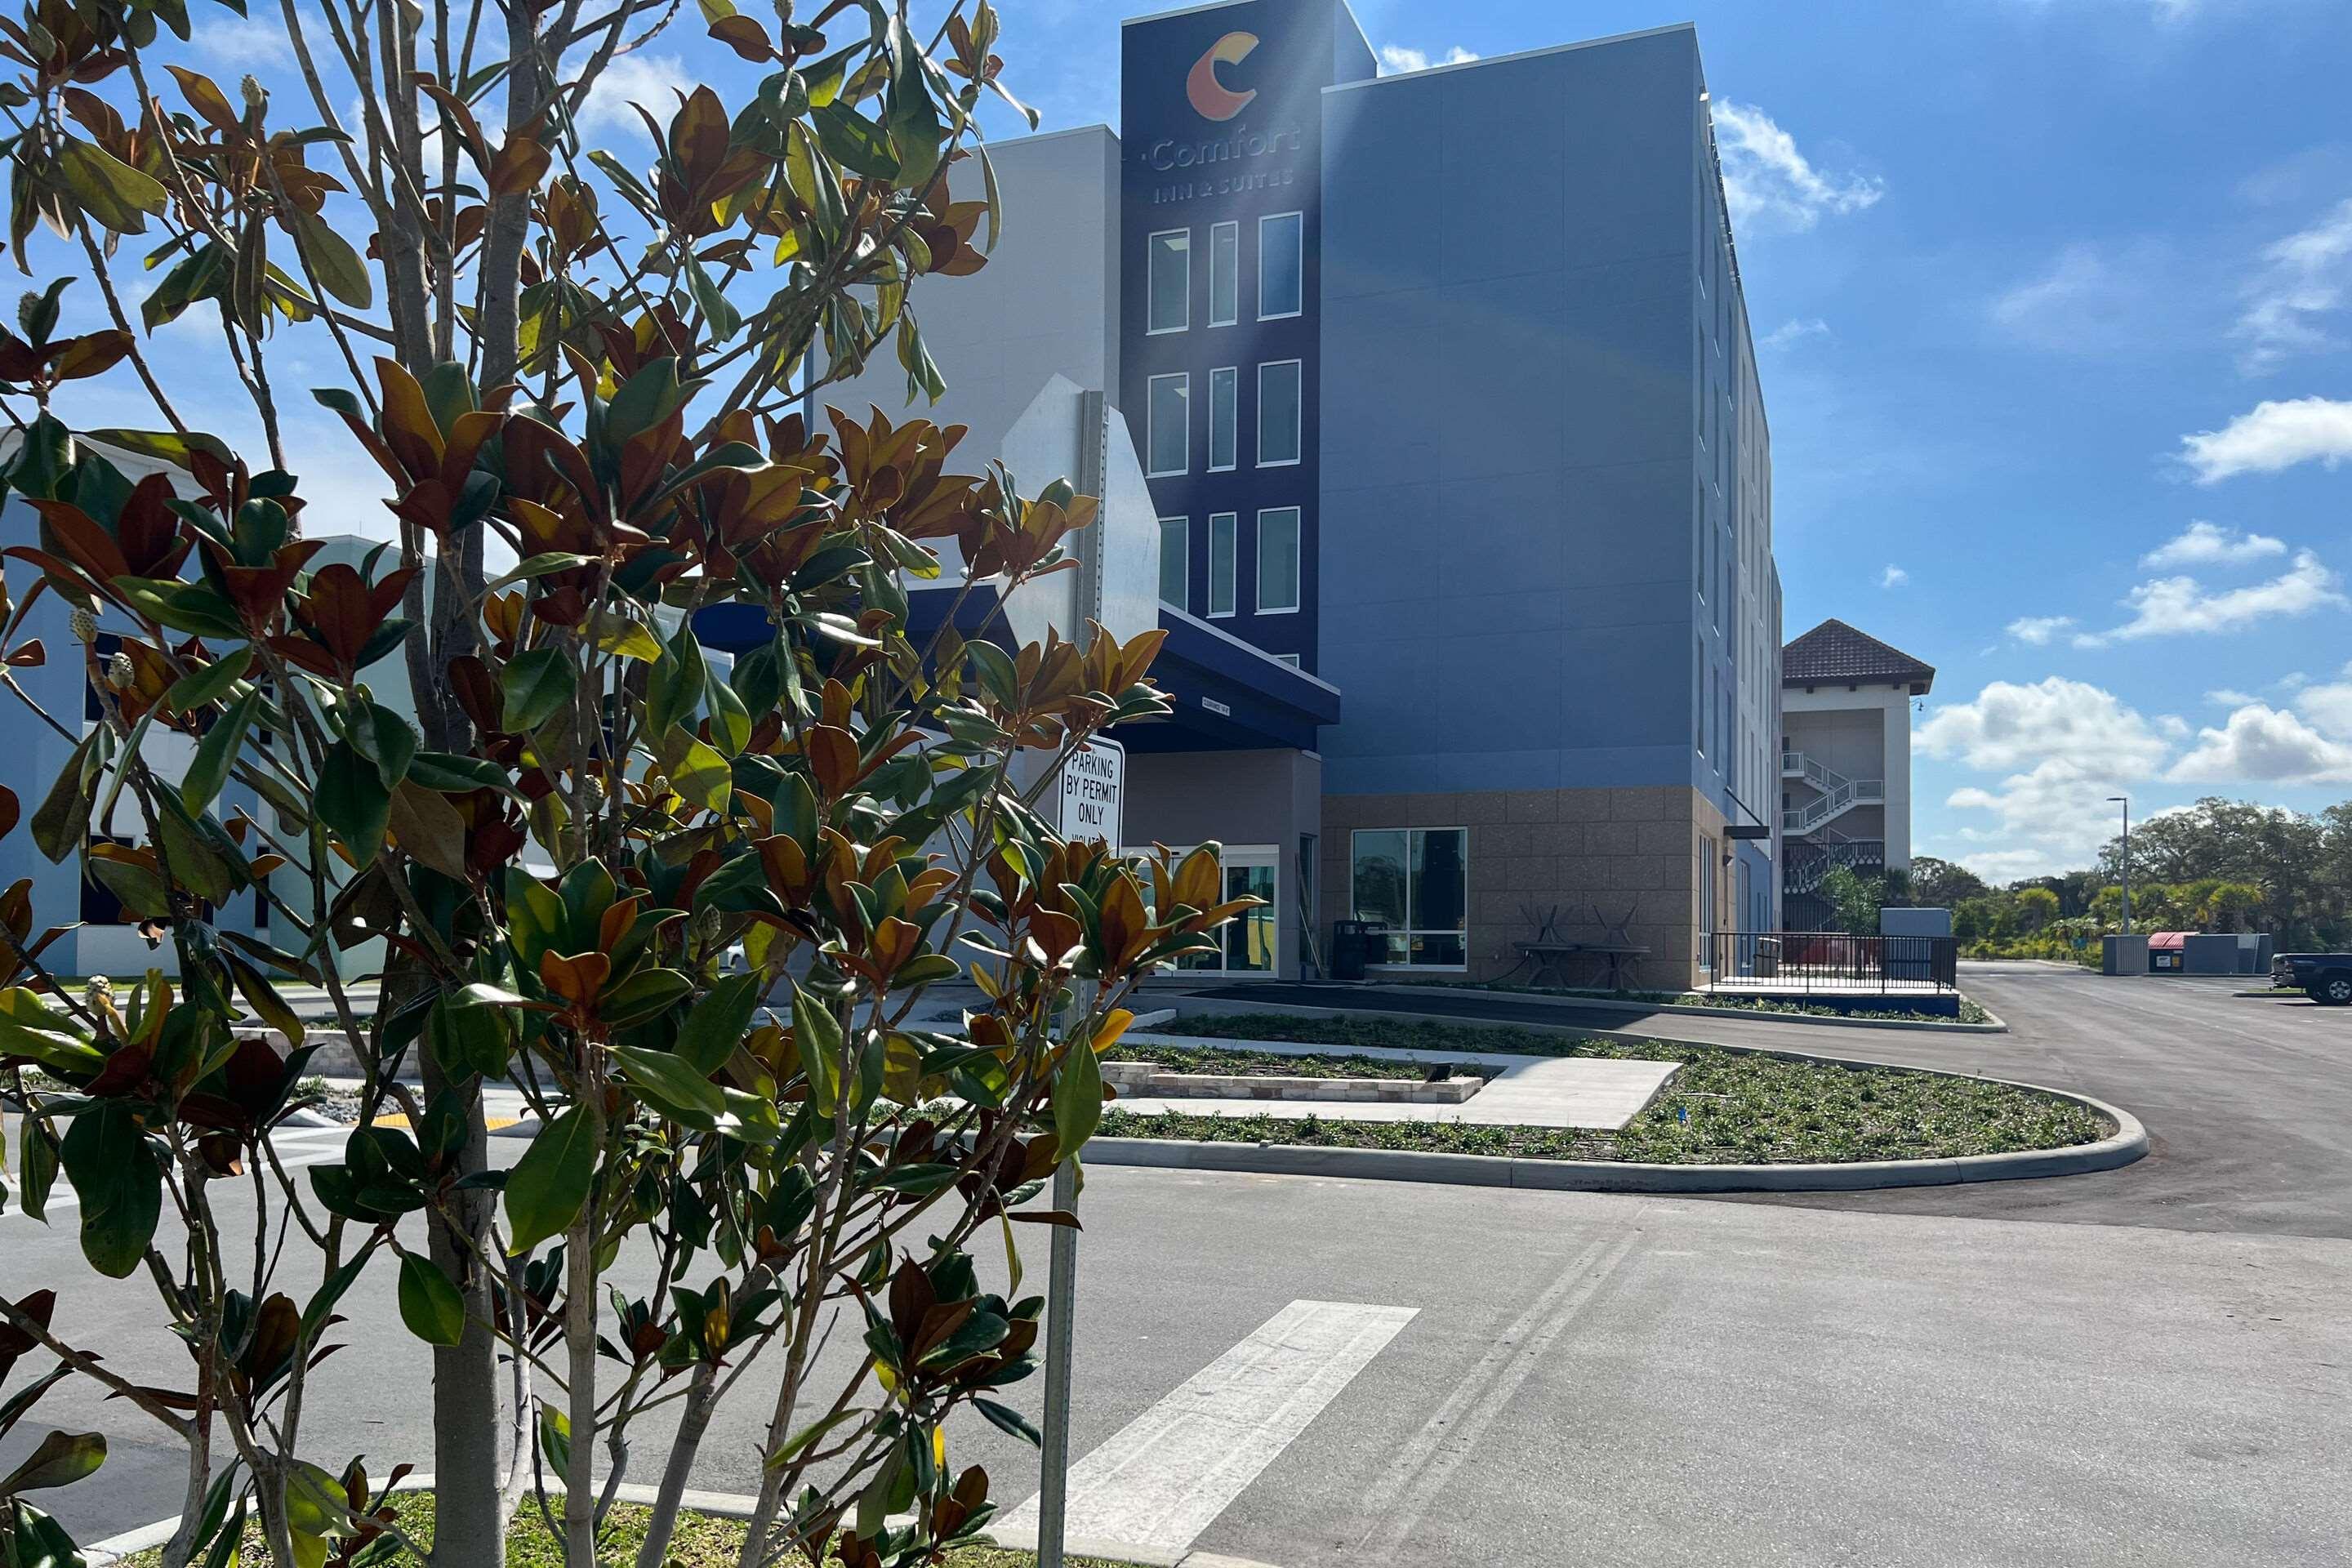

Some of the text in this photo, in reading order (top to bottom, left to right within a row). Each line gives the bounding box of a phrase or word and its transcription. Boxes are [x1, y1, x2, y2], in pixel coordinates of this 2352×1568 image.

[1151, 122, 1301, 171] Comfort
[1153, 182, 1194, 203] INN
[1218, 169, 1294, 195] SUITES
[1071, 752, 1113, 779] PARKING
[1067, 774, 1117, 804] BY PERMIT
[1078, 802, 1104, 826] ONLY
